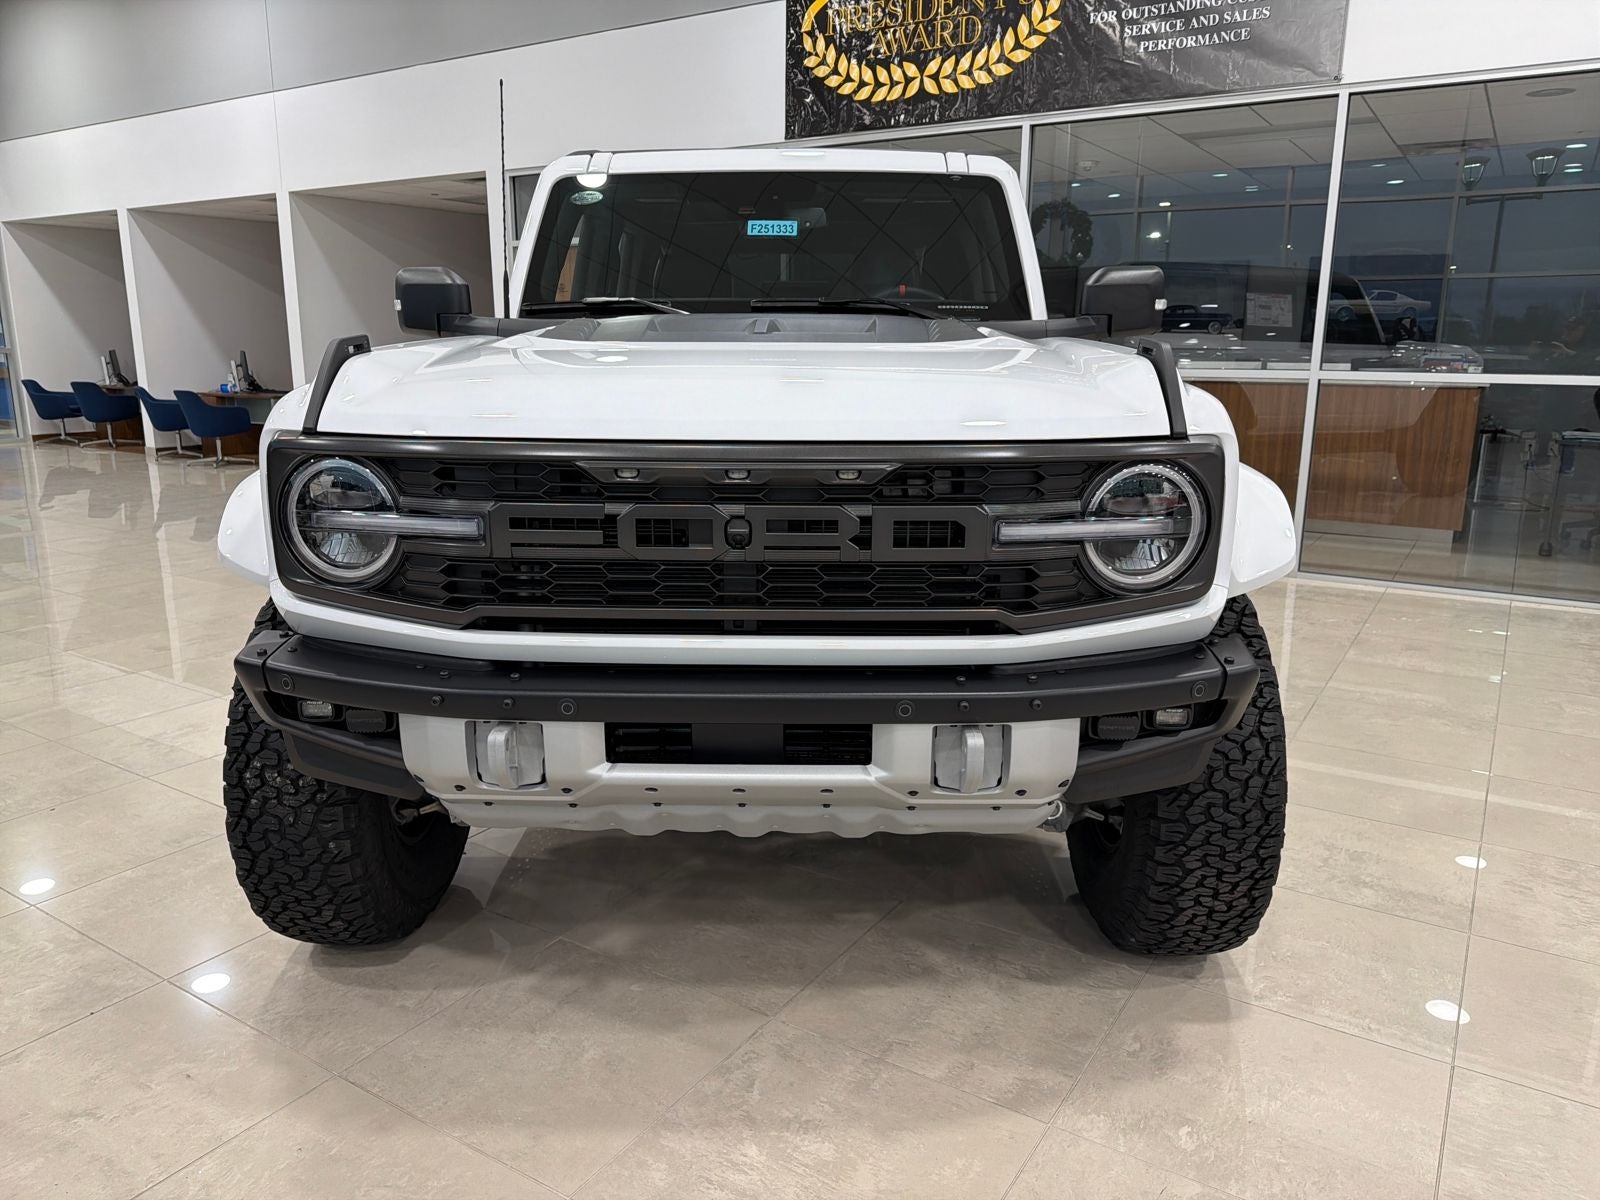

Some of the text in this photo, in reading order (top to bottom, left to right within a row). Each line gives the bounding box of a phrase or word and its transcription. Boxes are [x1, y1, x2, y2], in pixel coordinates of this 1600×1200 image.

[1089, 10, 1117, 24] FOR
[1123, 6, 1271, 38] SERVICE AND SALES
[867, 15, 983, 59] AWARD
[1140, 28, 1251, 53] PERFORMANCE
[750, 223, 794, 234] F251333
[489, 503, 988, 562] FORD
